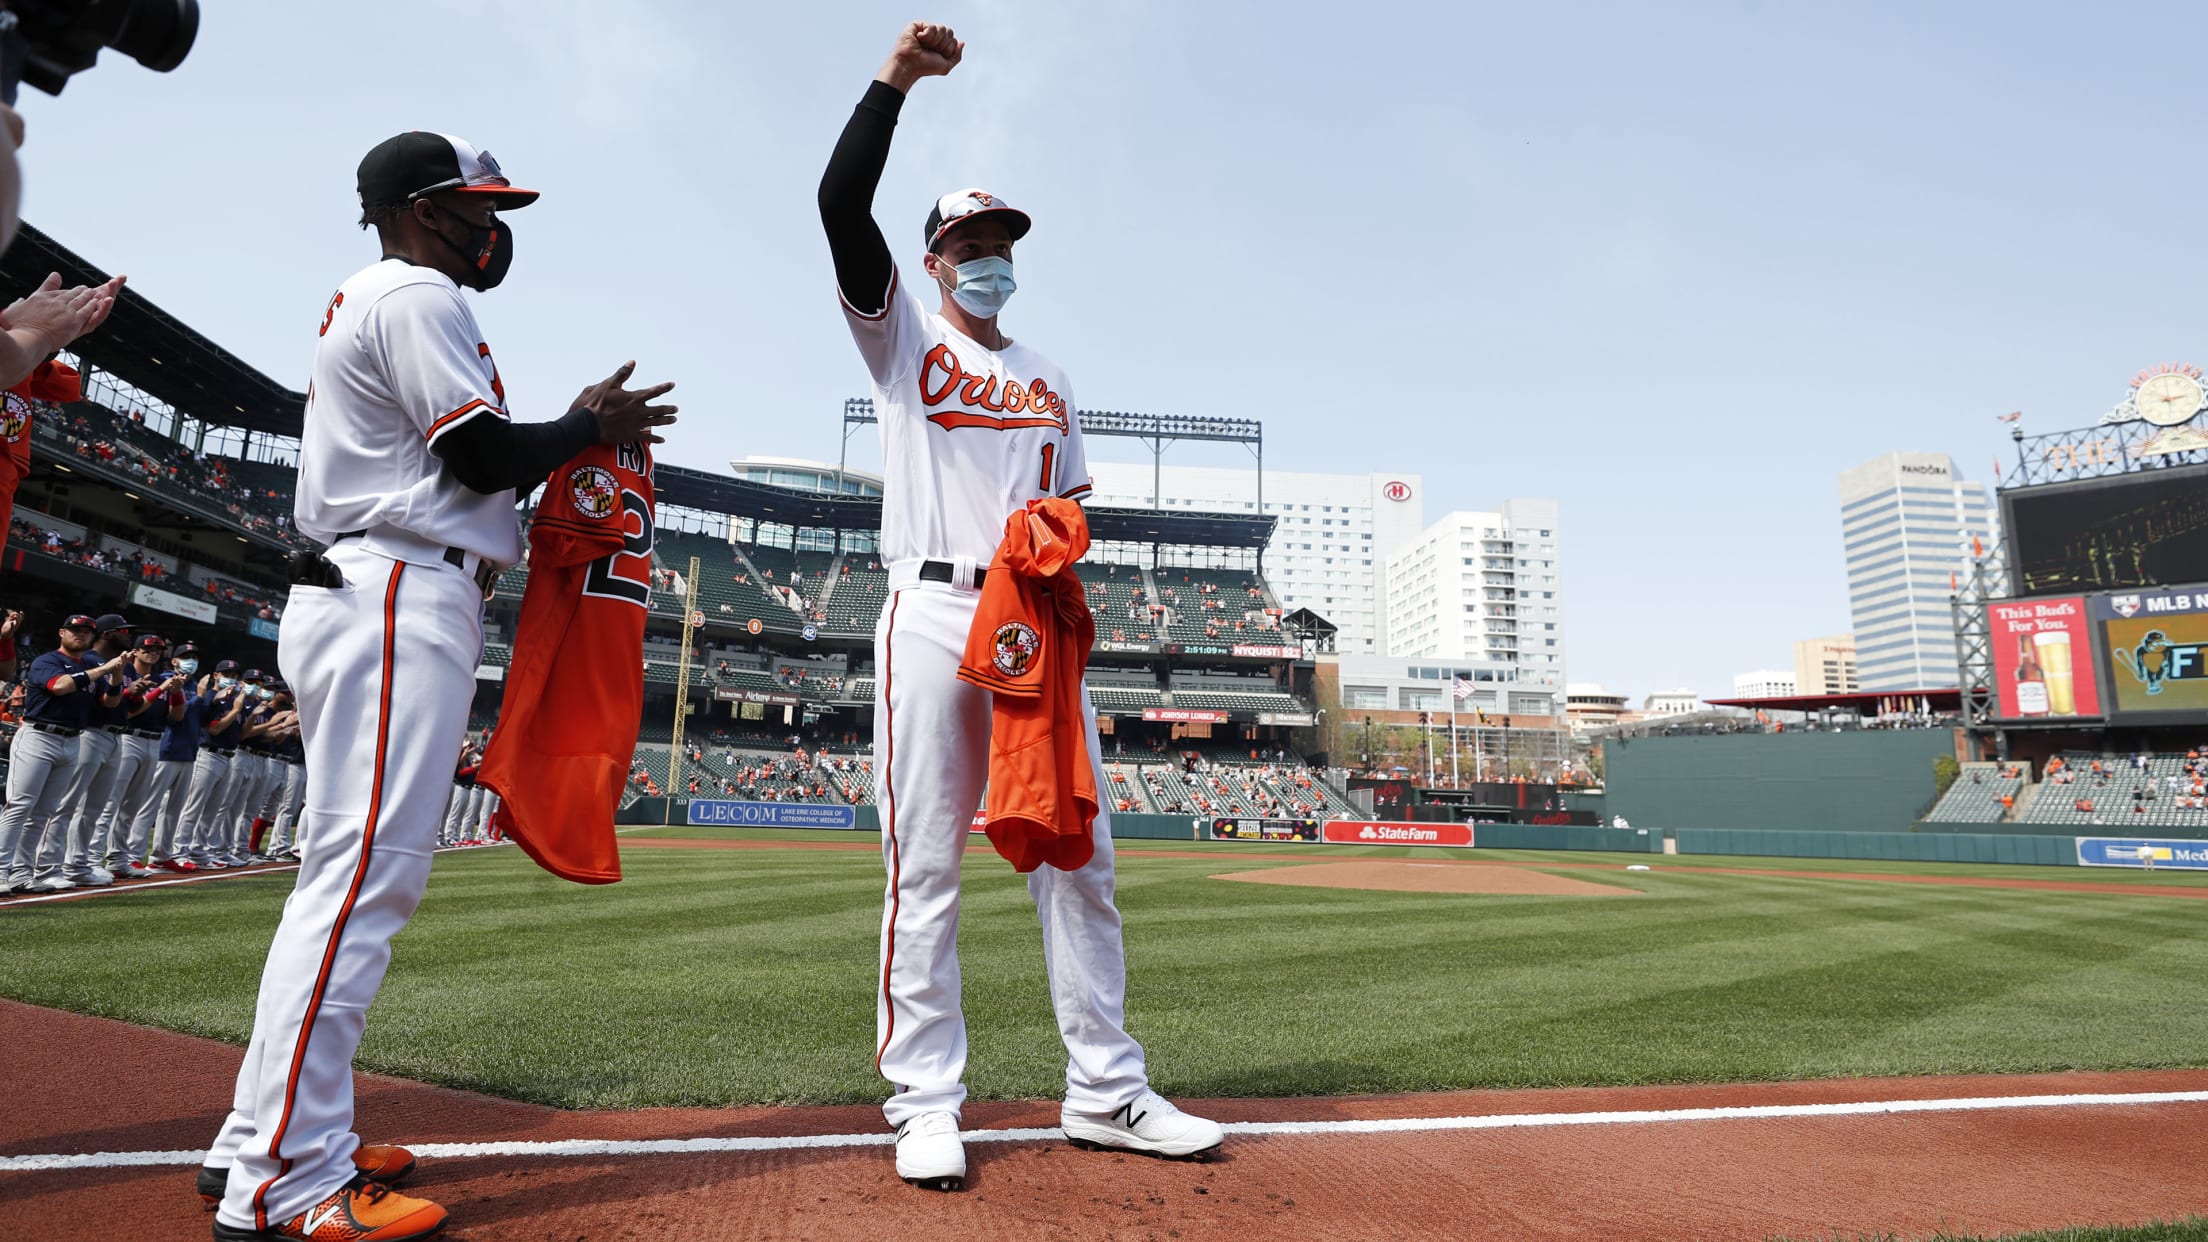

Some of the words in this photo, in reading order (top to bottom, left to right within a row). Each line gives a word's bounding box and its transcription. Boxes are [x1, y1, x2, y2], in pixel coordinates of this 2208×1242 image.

[571, 466, 620, 489] BALTIMORE
[574, 502, 612, 518] ORIOLES
[1996, 606, 2033, 620] This
[2035, 603, 2075, 617] Bud's
[2146, 594, 2192, 612] MLB
[2008, 620, 2033, 632] For
[2036, 617, 2069, 630] You.
[804, 629, 815, 638] 42
[996, 622, 1038, 649] BALTIMORE
[1184, 645, 1218, 654] 2:51:09
[993, 657, 1026, 676] ORIOLES
[699, 804, 777, 822] LECOM
[810, 809, 833, 817] COLLEGE
